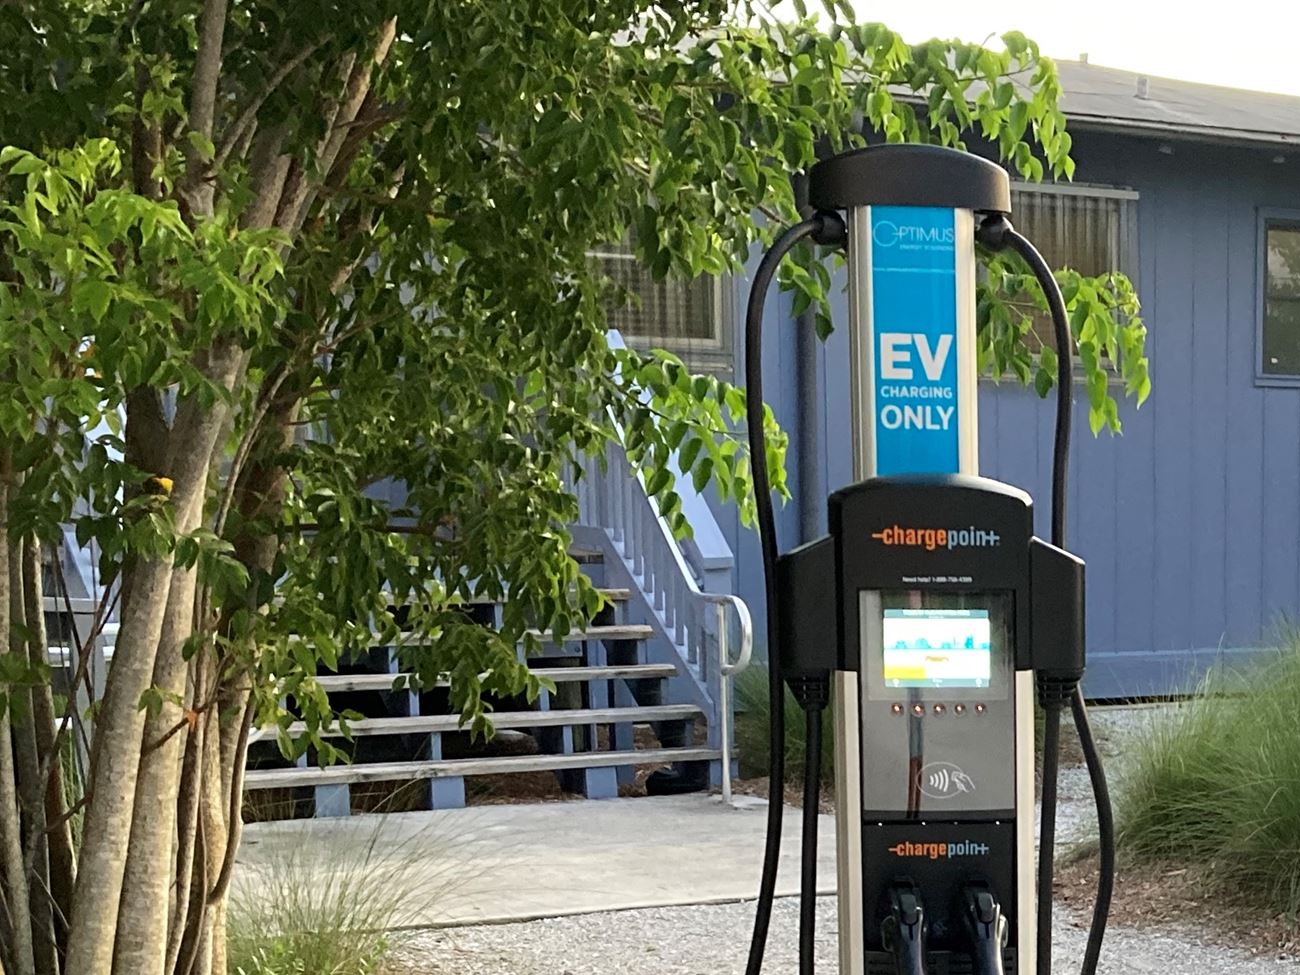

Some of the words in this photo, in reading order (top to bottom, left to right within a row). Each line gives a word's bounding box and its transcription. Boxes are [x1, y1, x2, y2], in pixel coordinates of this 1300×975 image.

[873, 221, 954, 247] OPTIMUS
[880, 332, 954, 381] EV
[880, 385, 953, 399] CHARGING
[880, 404, 955, 430] ONLY
